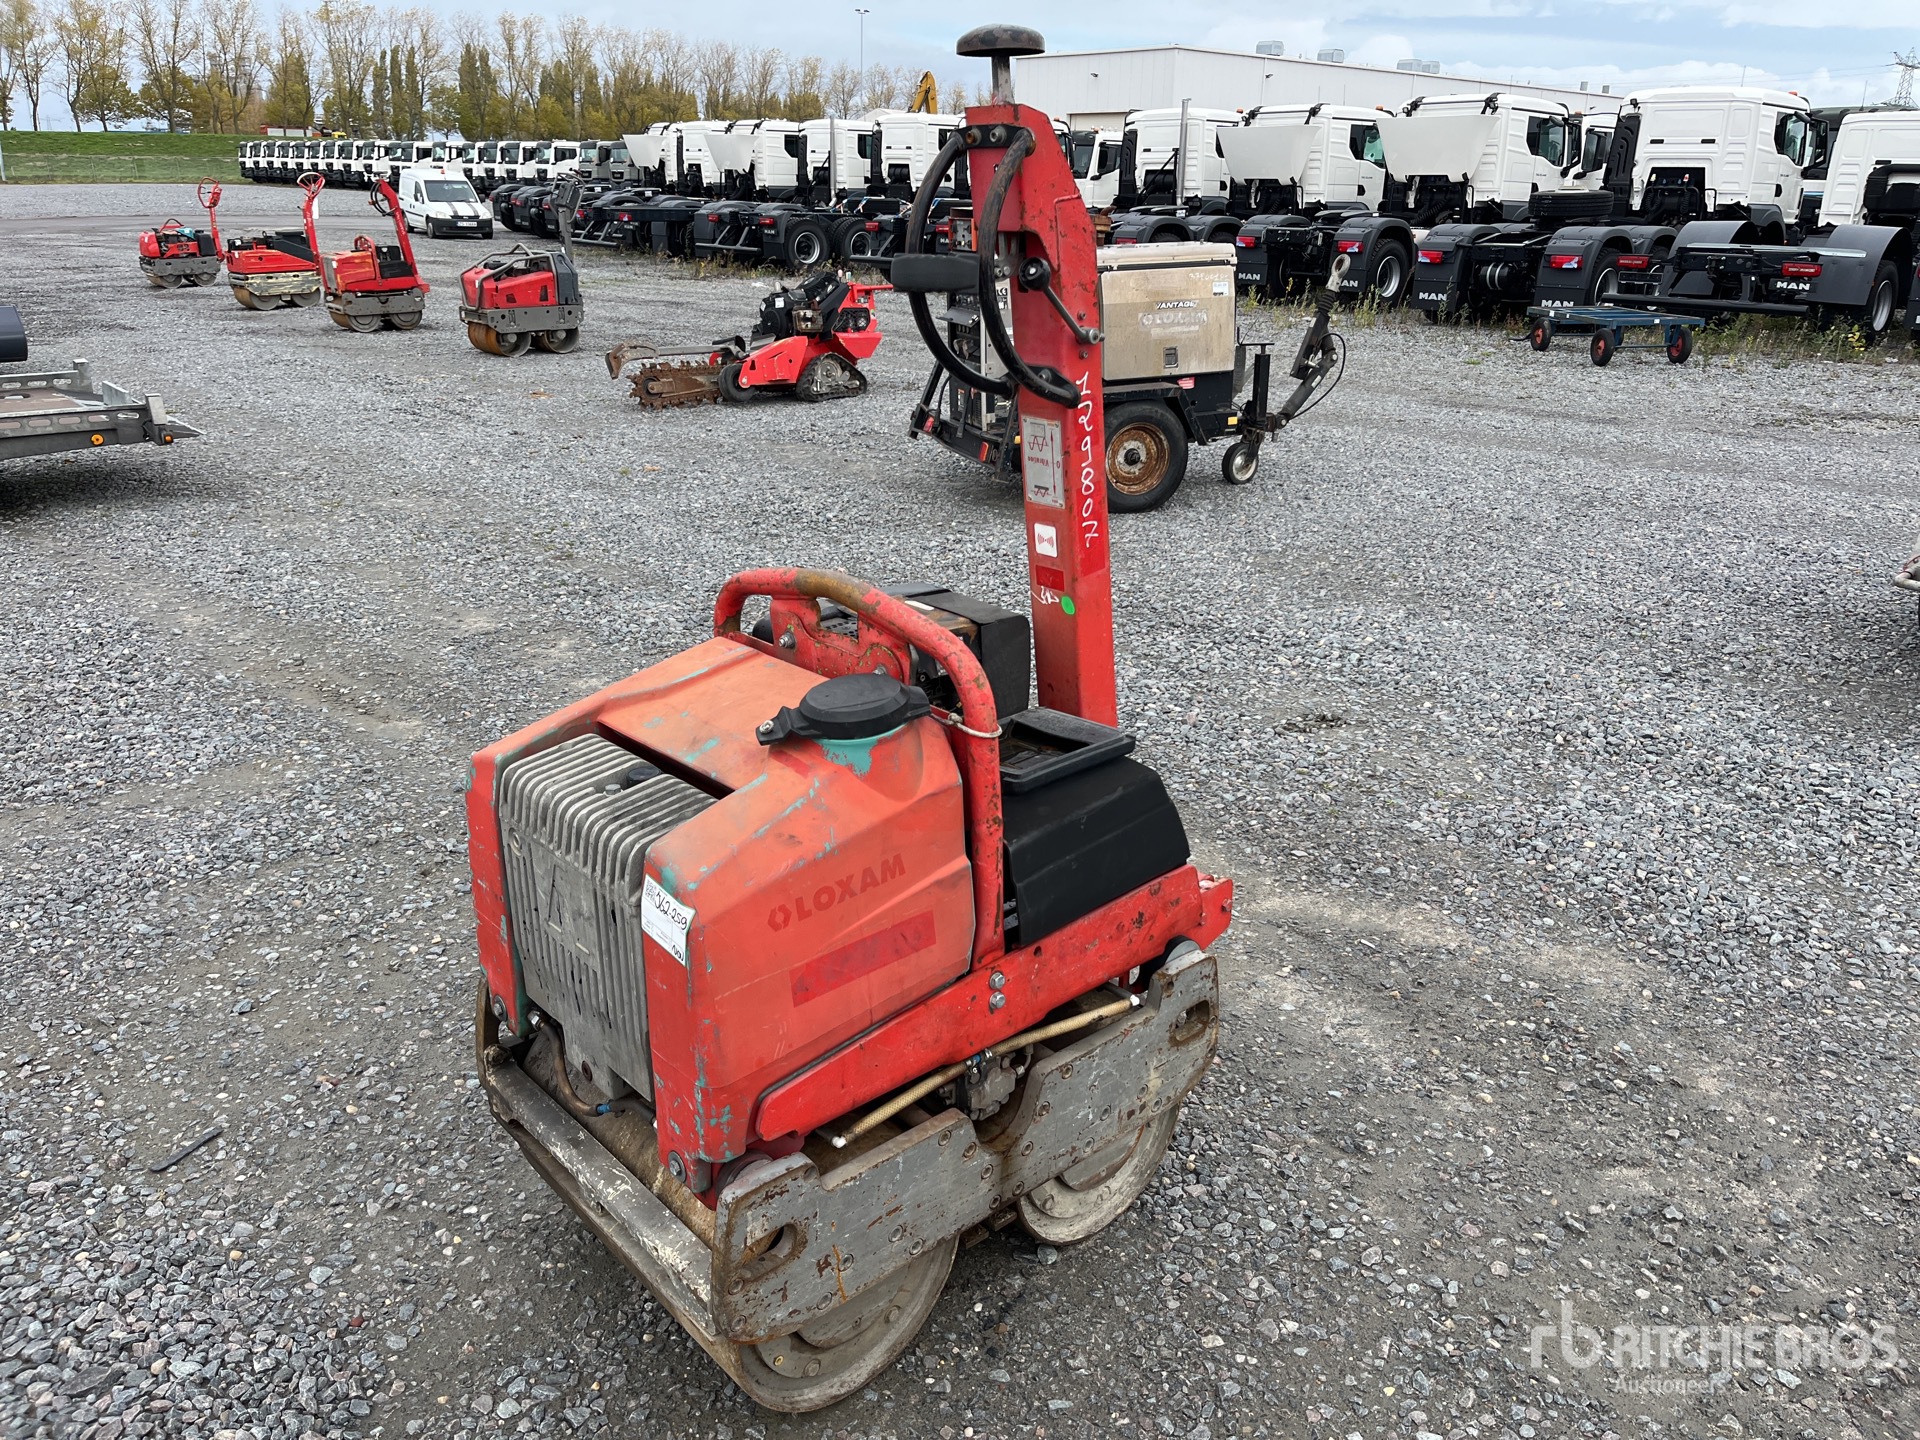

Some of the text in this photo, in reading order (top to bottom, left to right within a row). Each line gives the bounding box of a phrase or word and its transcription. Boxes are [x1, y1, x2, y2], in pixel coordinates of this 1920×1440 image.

[1238, 273, 1261, 281] MAN
[1776, 281, 1810, 290] MAN
[1418, 292, 1447, 300] MAN
[1155, 300, 1199, 310] VANTAGE
[1541, 299, 1574, 307] MAN
[795, 852, 906, 922] LOXAM
